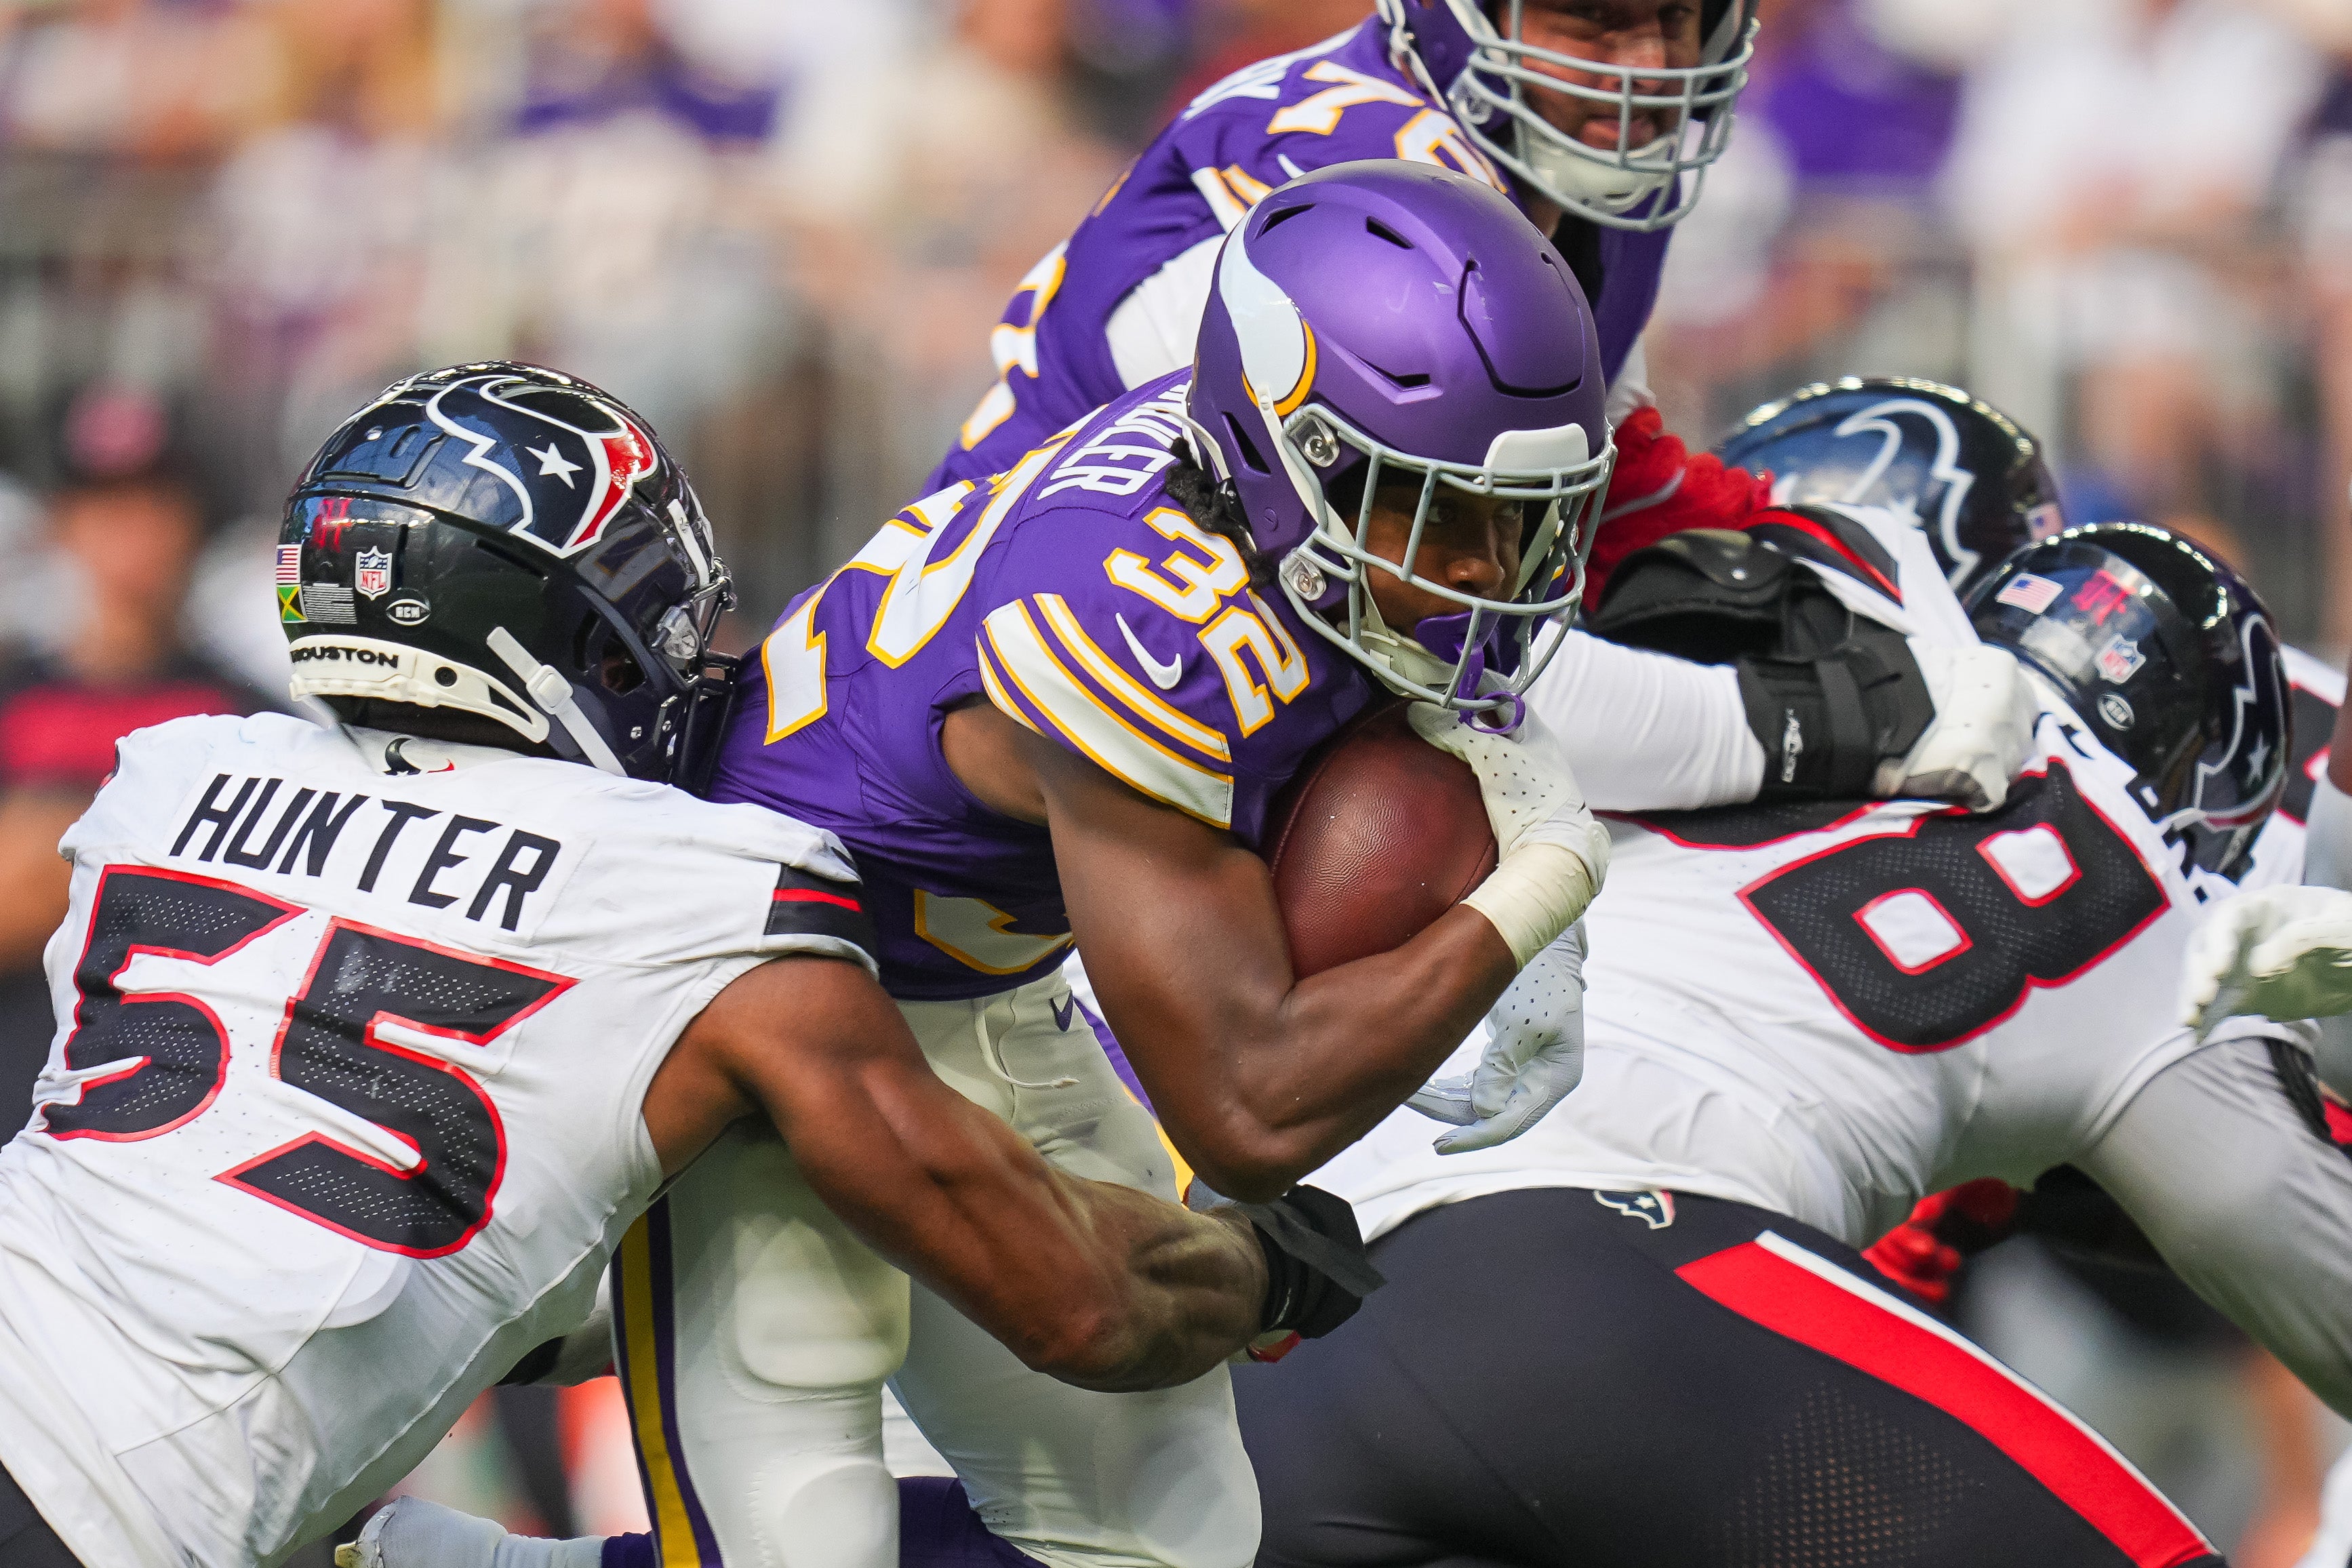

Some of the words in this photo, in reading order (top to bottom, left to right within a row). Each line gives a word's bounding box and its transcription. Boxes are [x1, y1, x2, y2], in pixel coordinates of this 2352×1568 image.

[361, 570, 387, 590] NFL
[1102, 506, 1310, 738] 32
[170, 773, 561, 932] HUNTER
[1597, 755, 2171, 1053] 8
[39, 864, 582, 1260] 55
